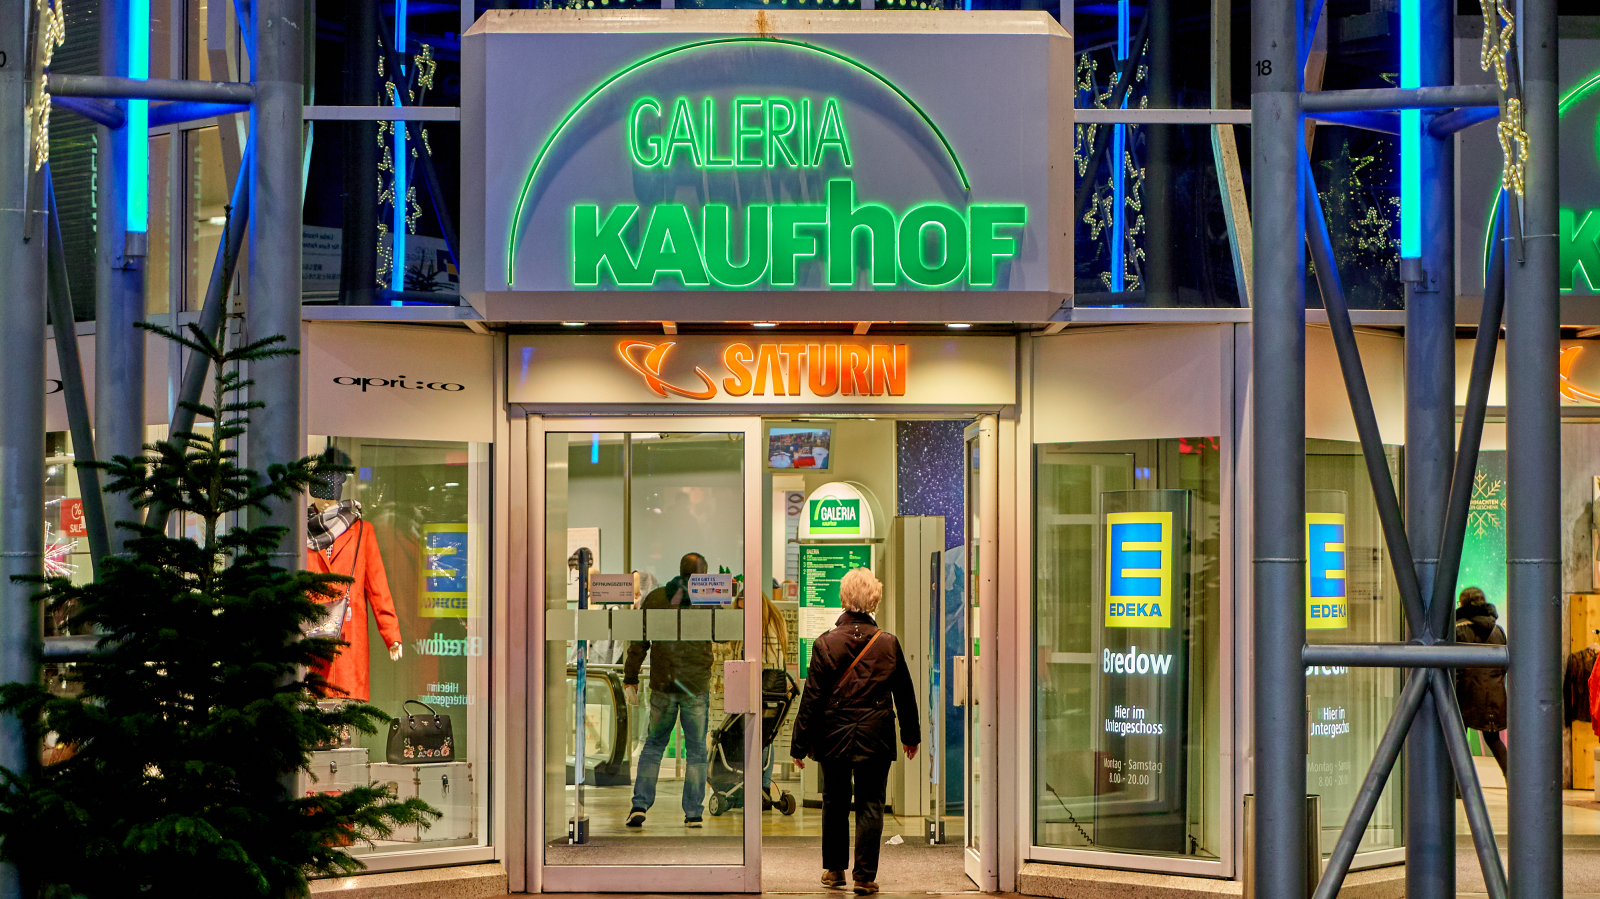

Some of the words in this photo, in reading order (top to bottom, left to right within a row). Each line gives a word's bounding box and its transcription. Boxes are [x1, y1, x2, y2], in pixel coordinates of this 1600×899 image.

[1255, 59, 1273, 77] 18
[630, 98, 852, 168] GALERIA
[723, 342, 907, 397] SATURN
[821, 506, 856, 521] GALERIA
[1109, 603, 1162, 617] EDEKA
[1103, 645, 1172, 675] Bredow
[1114, 705, 1130, 719] Hier
[1132, 705, 1145, 719] im
[1323, 706, 1338, 720] Hier
[1105, 718, 1163, 736] Untergeschoss
[1103, 757, 1122, 772] Montag
[1128, 759, 1163, 773] Samstag
[1109, 772, 1121, 784] 8.00
[1127, 774, 1150, 785] 20.00
